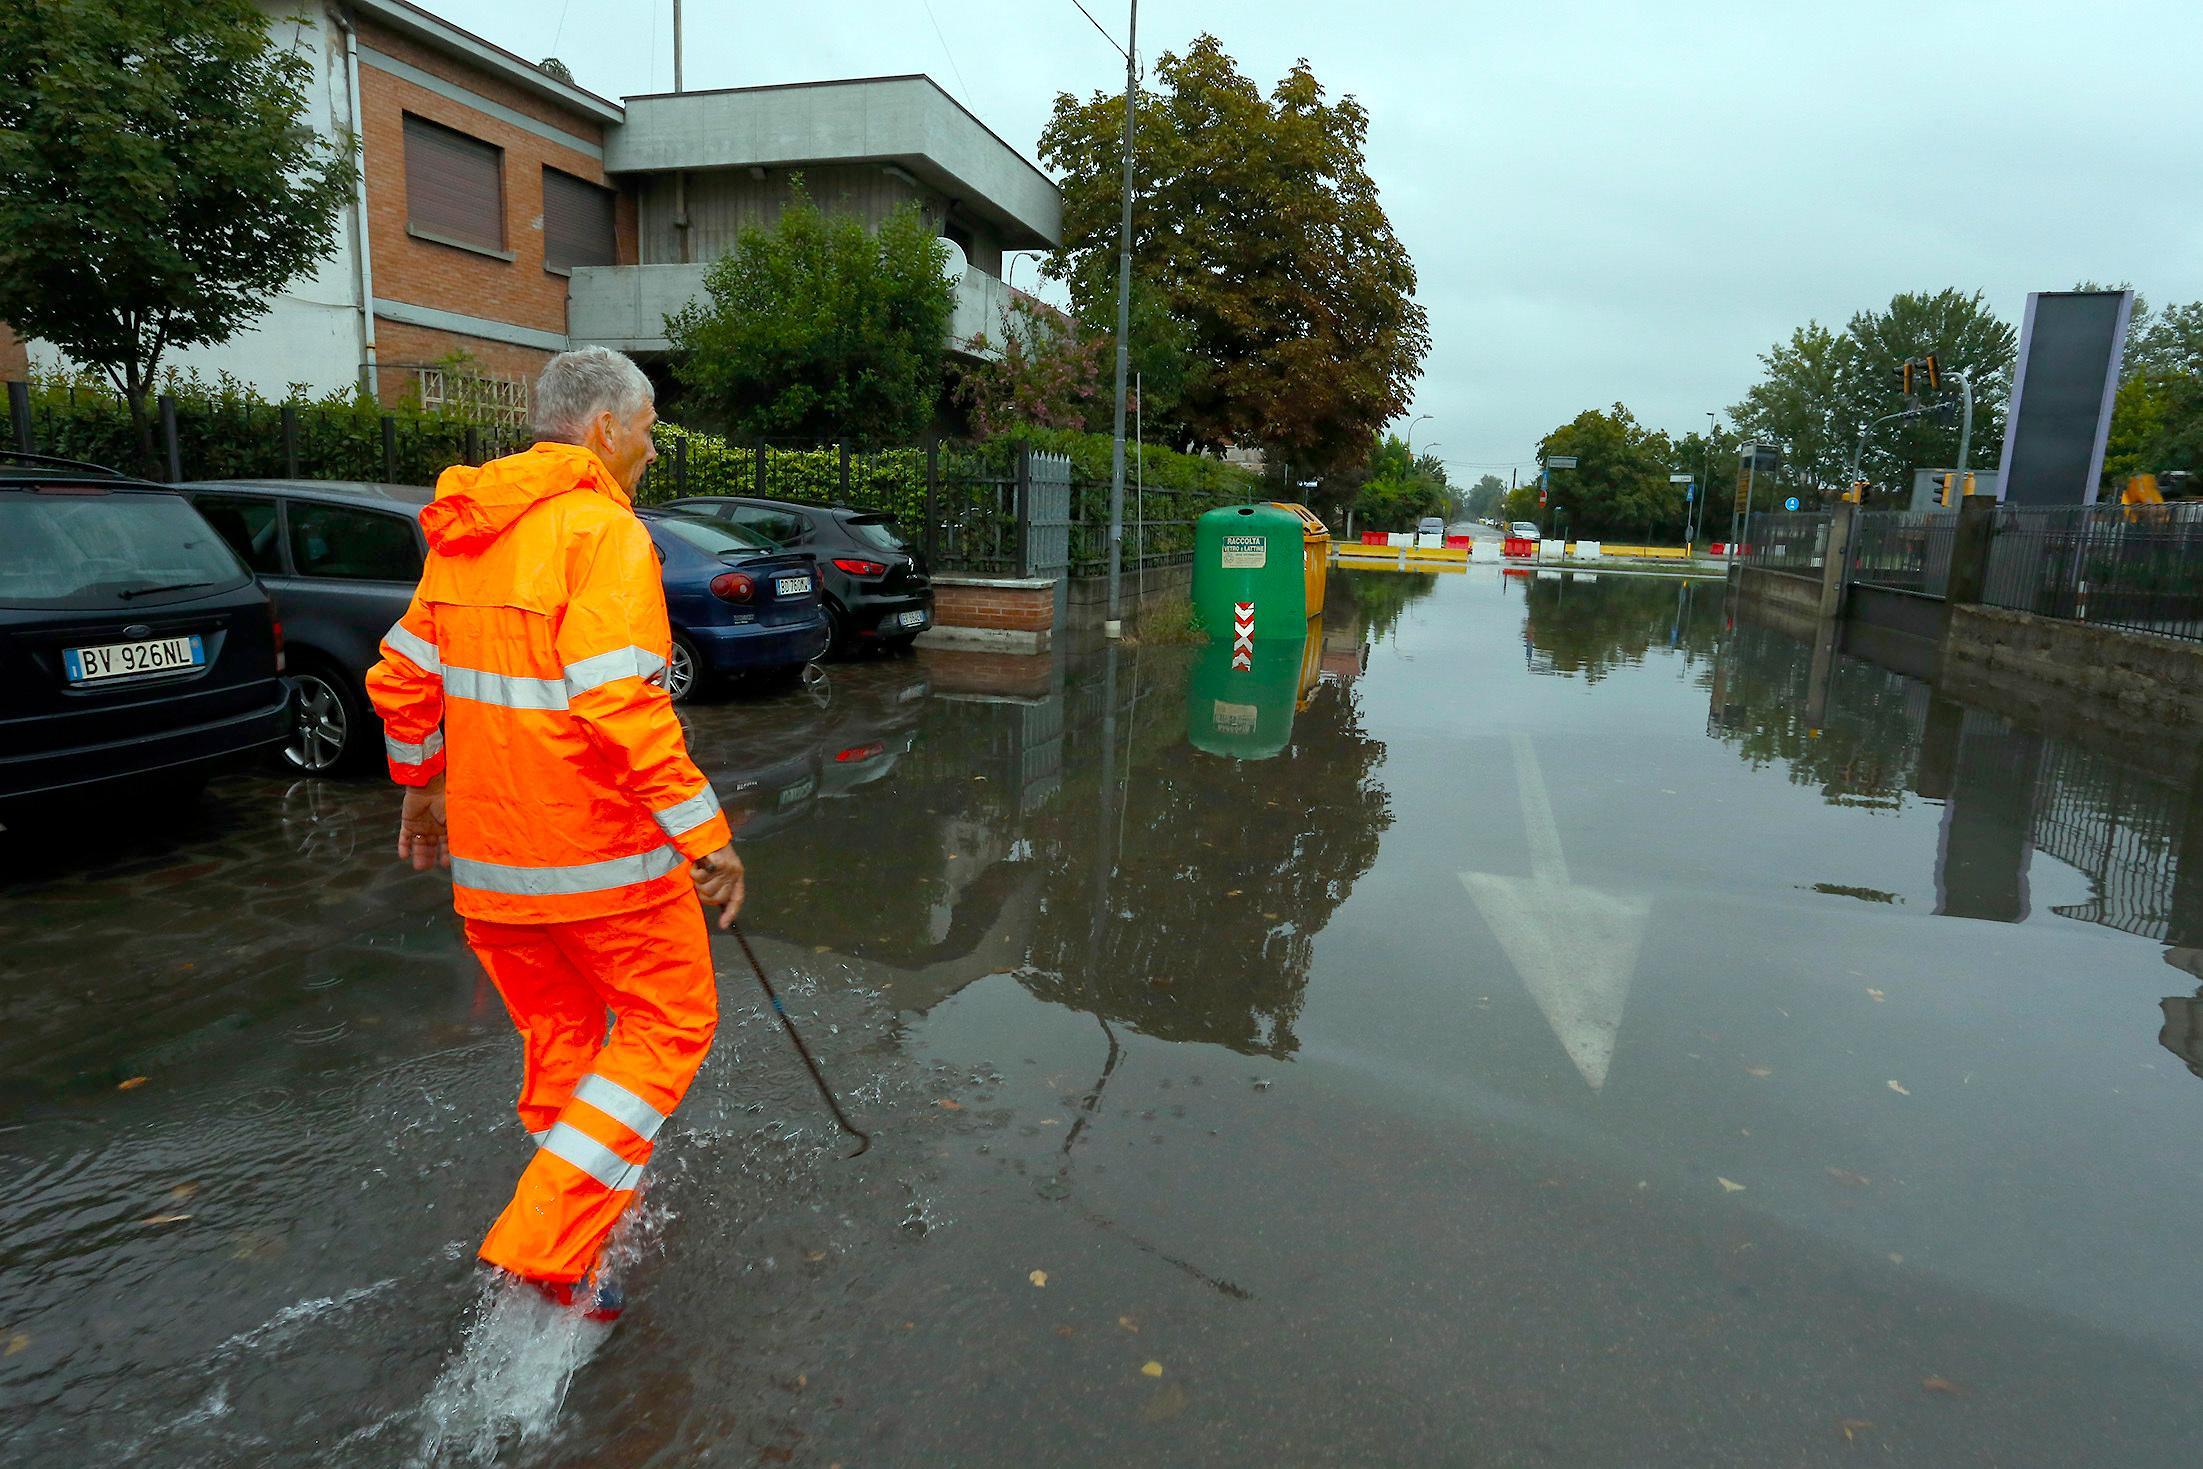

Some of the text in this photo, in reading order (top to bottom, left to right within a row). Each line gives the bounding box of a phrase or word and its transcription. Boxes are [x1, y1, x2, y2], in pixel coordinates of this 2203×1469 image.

[1227, 537, 1261, 545] RACCOLTA
[82, 640, 190, 676] BV 926NL
